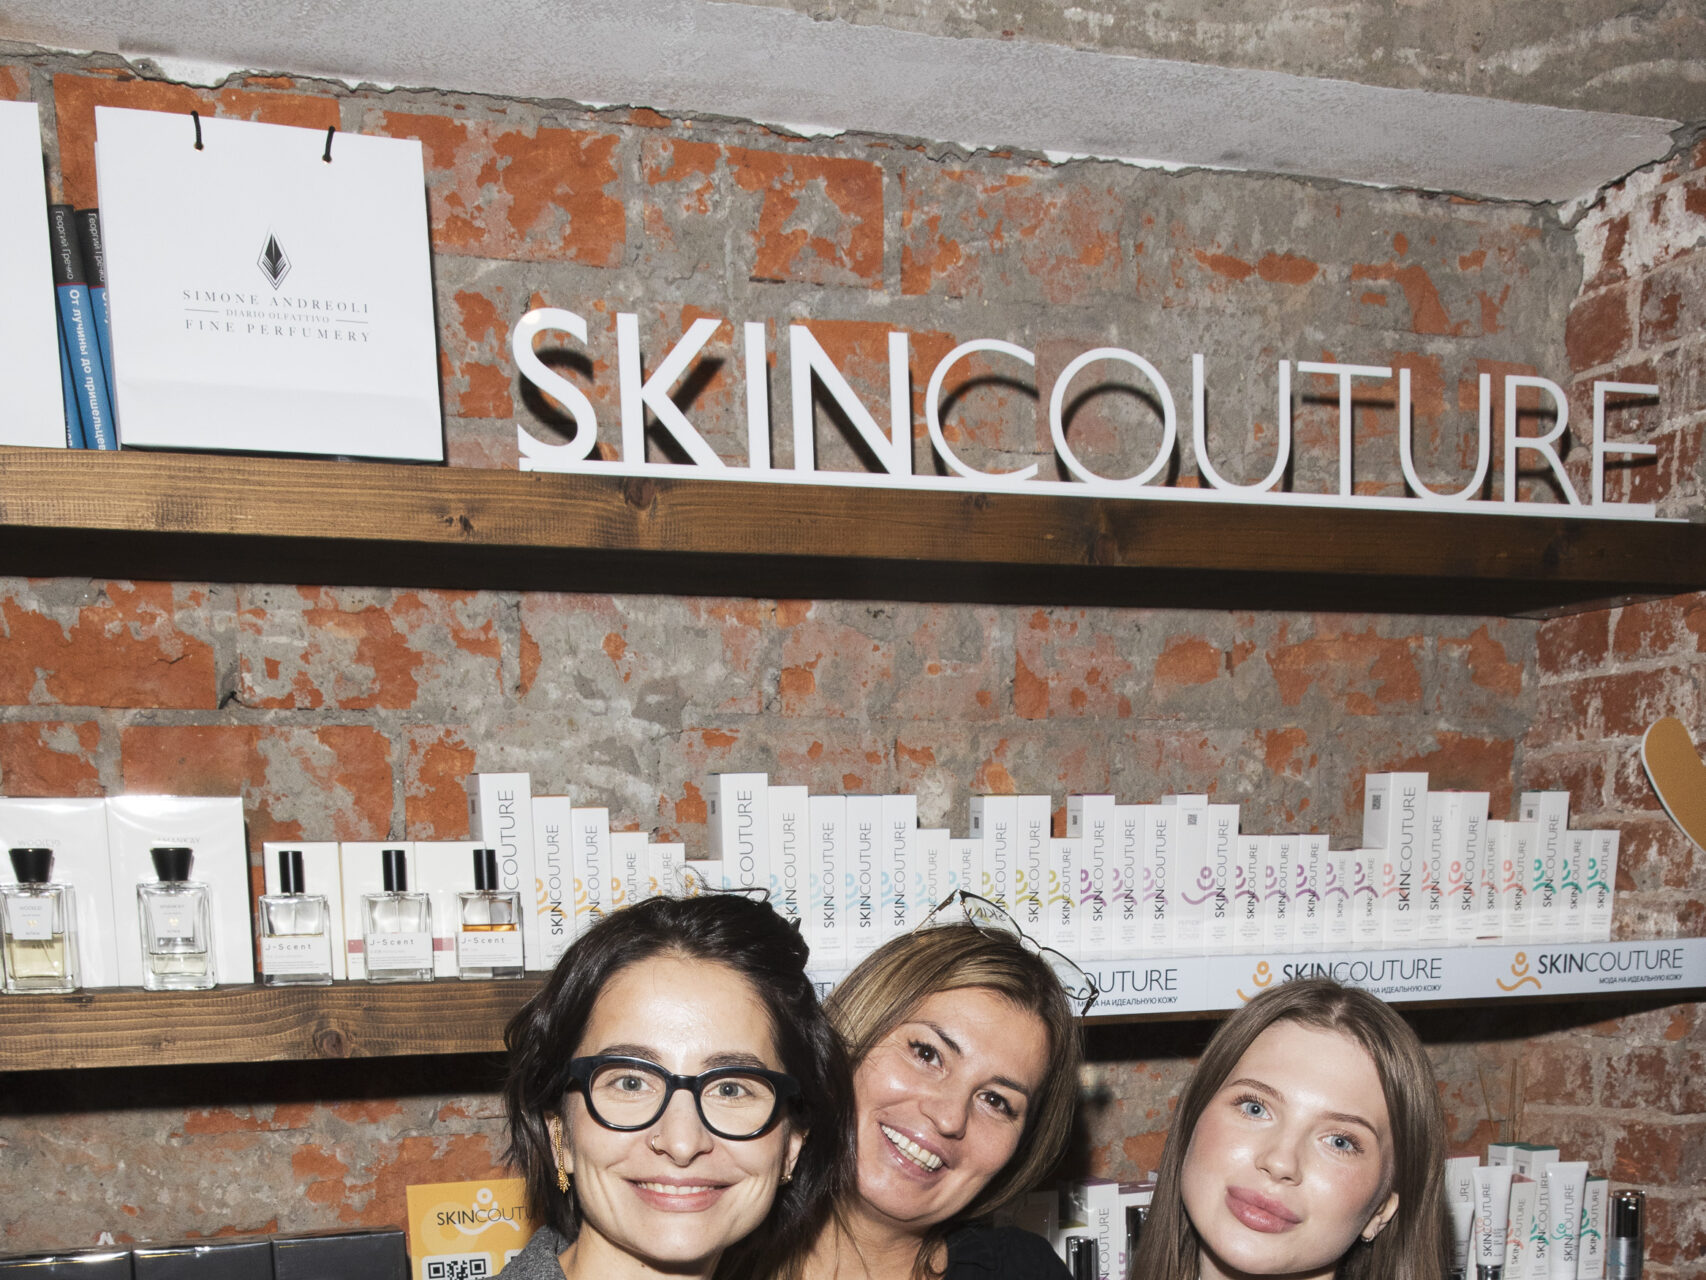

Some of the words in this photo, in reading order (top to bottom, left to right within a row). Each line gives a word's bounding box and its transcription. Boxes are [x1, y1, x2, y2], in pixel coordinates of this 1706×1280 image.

[69, 289, 81, 303] От
[72, 305, 89, 355] лучины
[183, 289, 259, 305] SIMONE
[269, 296, 369, 314] ANDREOLI
[185, 319, 235, 333] FINE
[246, 323, 370, 342] PERFUMERY
[226, 308, 265, 319] DIARIO
[268, 312, 330, 324] OLFATTIVO
[80, 356, 92, 374] до
[511, 306, 1659, 519] SKINCOUTURE
[546, 824, 563, 935] SKINCOUTURE
[822, 822, 835, 929] SKINCOUTURE
[859, 822, 872, 928] SKINCOUTURE
[894, 821, 906, 927] SKINCOUTURE
[1029, 820, 1041, 923] SKINCOUTURE
[1093, 820, 1105, 921] SKINCOUTURE
[1124, 819, 1136, 920] SKINCOUTURE
[1155, 819, 1167, 920] SKINCOUTURE
[1215, 818, 1229, 918] SKINCOUTURE
[1399, 786, 1416, 911] SKINCOUTURE
[461, 936, 506, 945] J-Scent
[1538, 948, 1684, 974] SKINCOUTURE
[1100, 998, 1111, 1007] НА
[1111, 996, 1157, 1007] ИДЕАЛЬНУЮ
[1157, 995, 1178, 1004] КОЖУ
